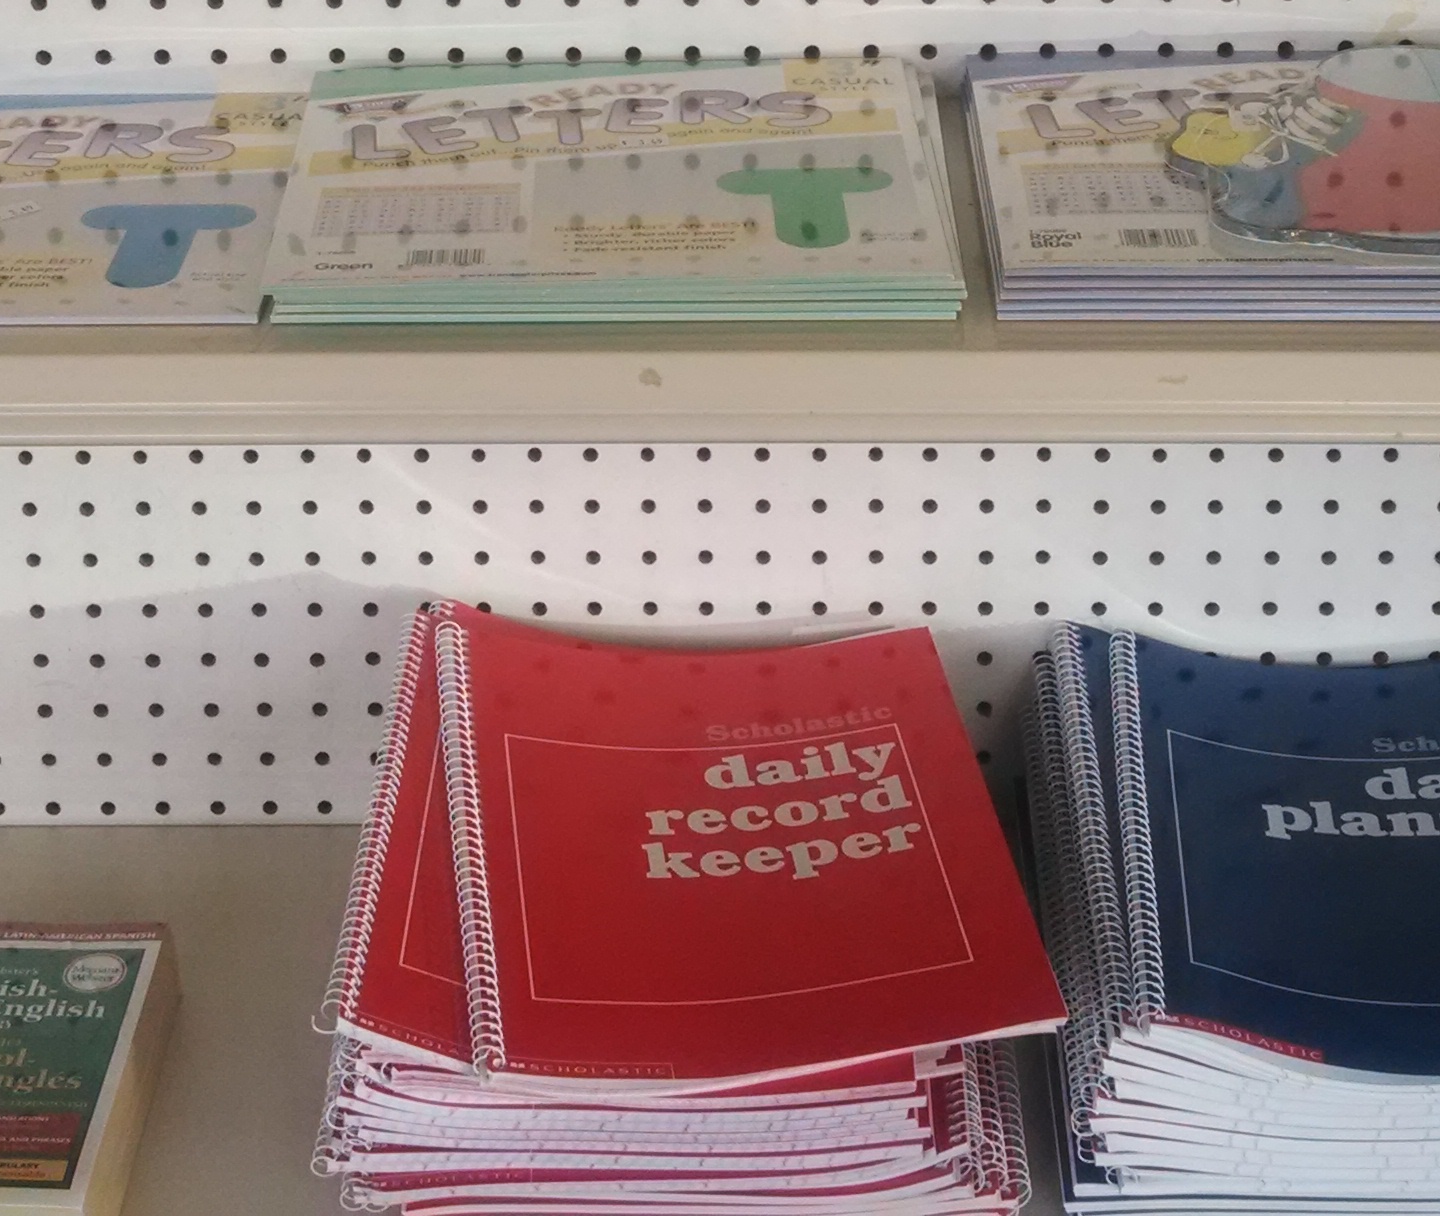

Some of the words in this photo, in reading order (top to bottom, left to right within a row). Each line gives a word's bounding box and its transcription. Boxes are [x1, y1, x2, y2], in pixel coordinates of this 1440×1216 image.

[526, 82, 678, 108] READY
[350, 88, 834, 161] LETTERS
[1028, 229, 1083, 243] Royal
[1029, 239, 1074, 250] Blue
[314, 261, 374, 271] Green
[705, 706, 893, 742] Scholastic
[703, 741, 897, 790] daily
[644, 774, 913, 836] record
[640, 821, 922, 881] keeper
[105, 931, 158, 941] SPANISH
[1183, 1017, 1323, 1061] SCHOLASTIC
[529, 1062, 667, 1075] SCHOLASTIC
